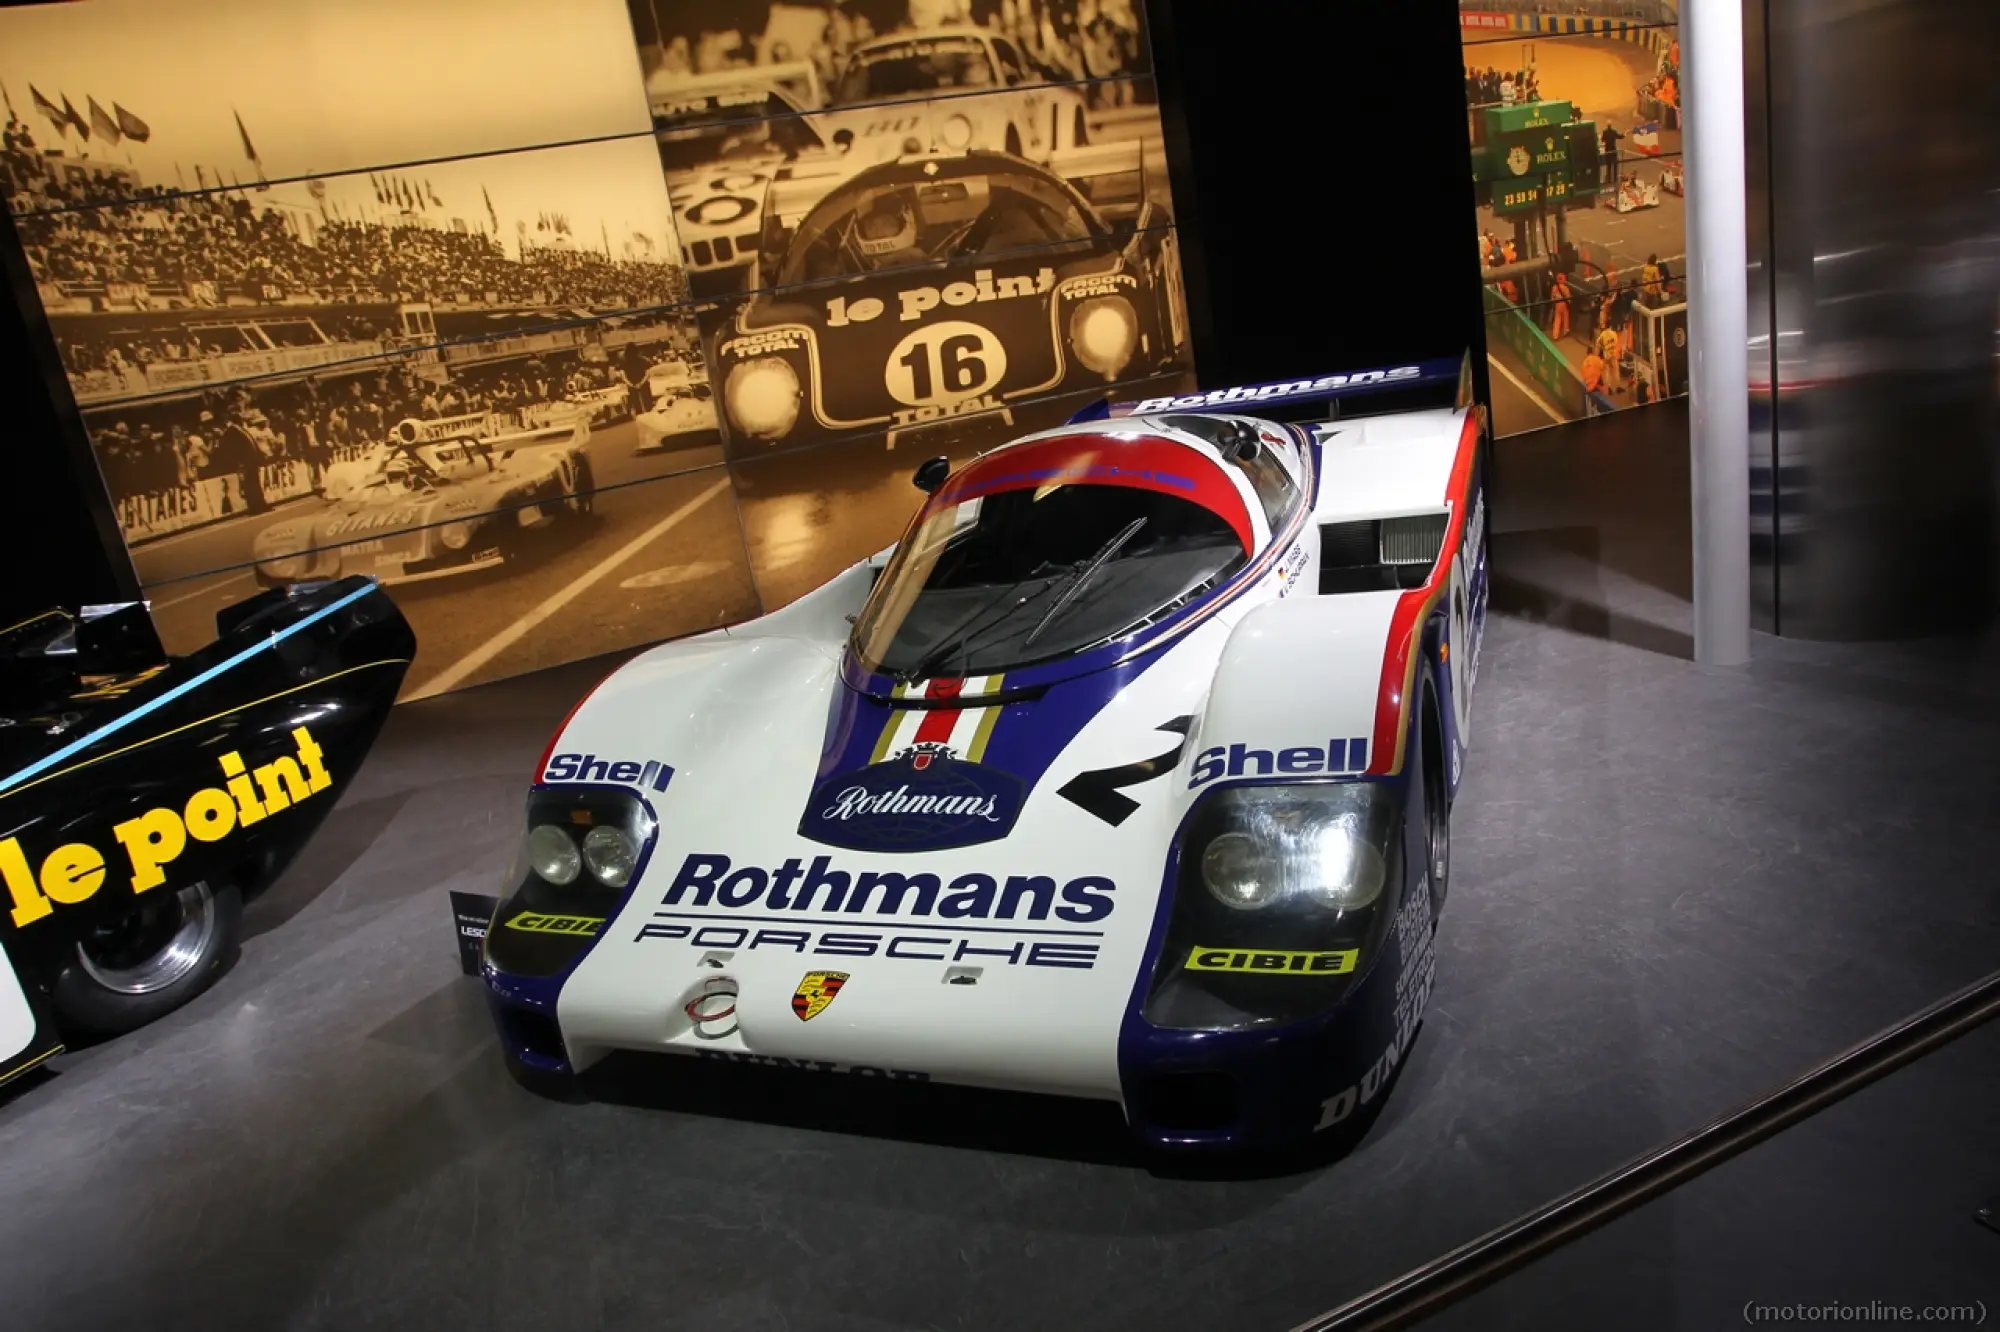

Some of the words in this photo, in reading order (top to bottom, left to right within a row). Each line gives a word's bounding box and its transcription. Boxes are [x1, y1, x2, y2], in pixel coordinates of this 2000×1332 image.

[1536, 151, 1566, 164] ROLEX
[826, 297, 885, 327] le
[899, 267, 1057, 321] point
[1063, 284, 1119, 301] TOTAL
[733, 339, 800, 358] TOTAL
[899, 333, 987, 400] 16
[892, 395, 1005, 427] TOTAL
[1132, 366, 1421, 414] Rothmans
[545, 753, 676, 793] Shell
[1056, 714, 1202, 827] 2
[1188, 738, 1368, 790] Shell
[0, 837, 107, 928] le
[113, 726, 333, 894] point
[822, 785, 1001, 821] Rothmans
[661, 853, 1117, 923] Rothmans
[634, 923, 1100, 969] PORSCHE
[1313, 960, 1437, 1132] DUNLOP
